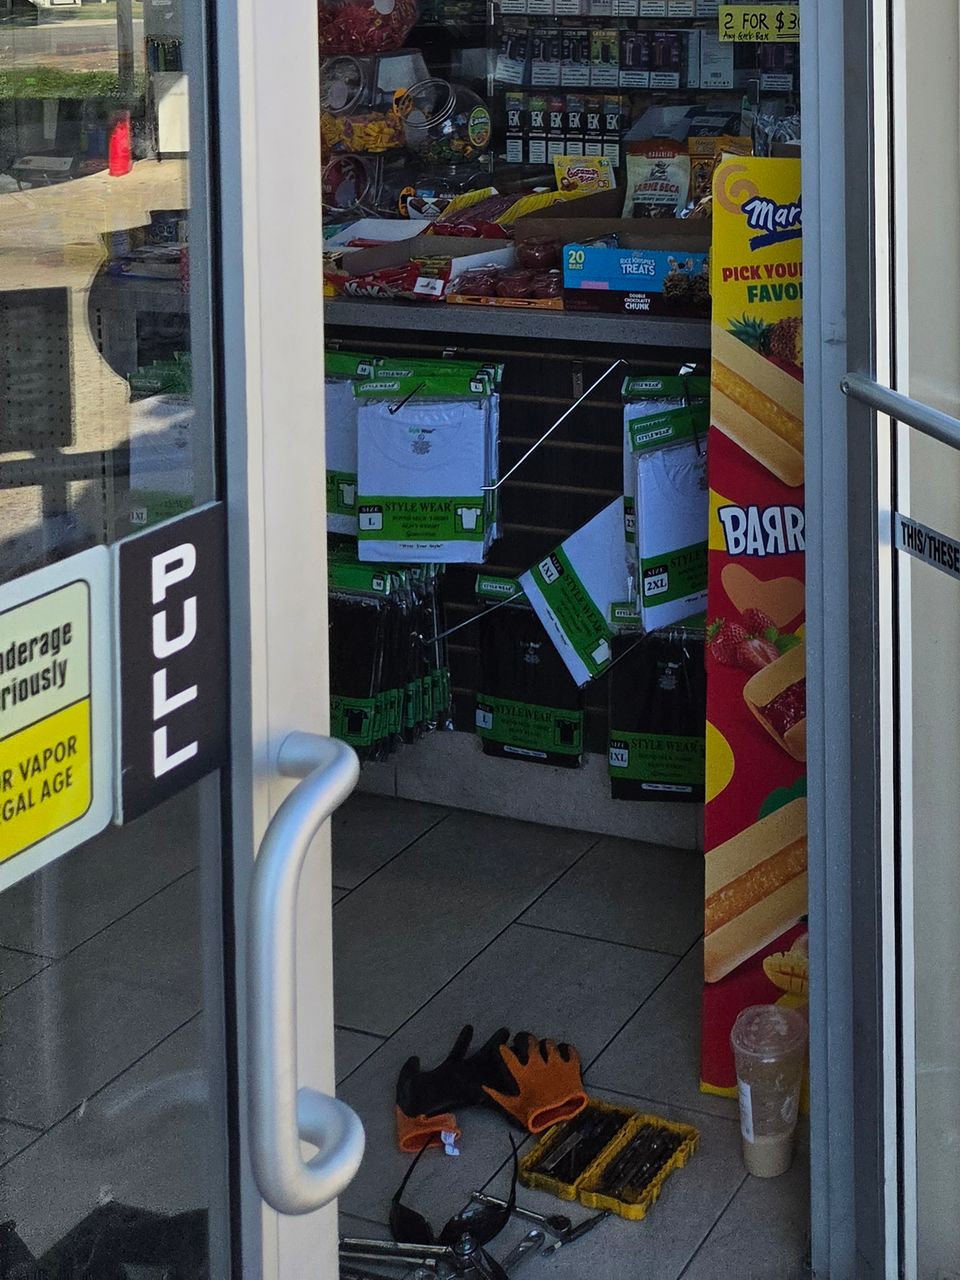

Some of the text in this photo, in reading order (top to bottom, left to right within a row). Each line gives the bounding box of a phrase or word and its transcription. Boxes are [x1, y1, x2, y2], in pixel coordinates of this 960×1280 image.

[724, 10, 800, 32] 2 FOR $3
[744, 199, 802, 231] Mar
[568, 250, 585, 264] 20
[621, 264, 655, 276] TREATS
[722, 263, 803, 282] PICK YOU
[747, 282, 803, 303] FAVO
[625, 303, 650, 311] CHUNK
[385, 502, 452, 513] STYLE WEAR
[368, 517, 376, 526] L
[900, 520, 960, 574] THIS/THESE
[670, 549, 701, 569] STYLE
[541, 561, 557, 581] 1XL
[646, 566, 667, 577] SIZE
[646, 578, 667, 592] 2XL
[564, 573, 602, 634] STYLE WEAR
[151, 542, 198, 778] PULL
[482, 713, 489, 724] L
[494, 704, 553, 723] STYLE WEAR
[630, 739, 698, 753] STYLE WEAR
[19, 735, 77, 782] VAPOR
[0, 765, 74, 823] GAL AGE
